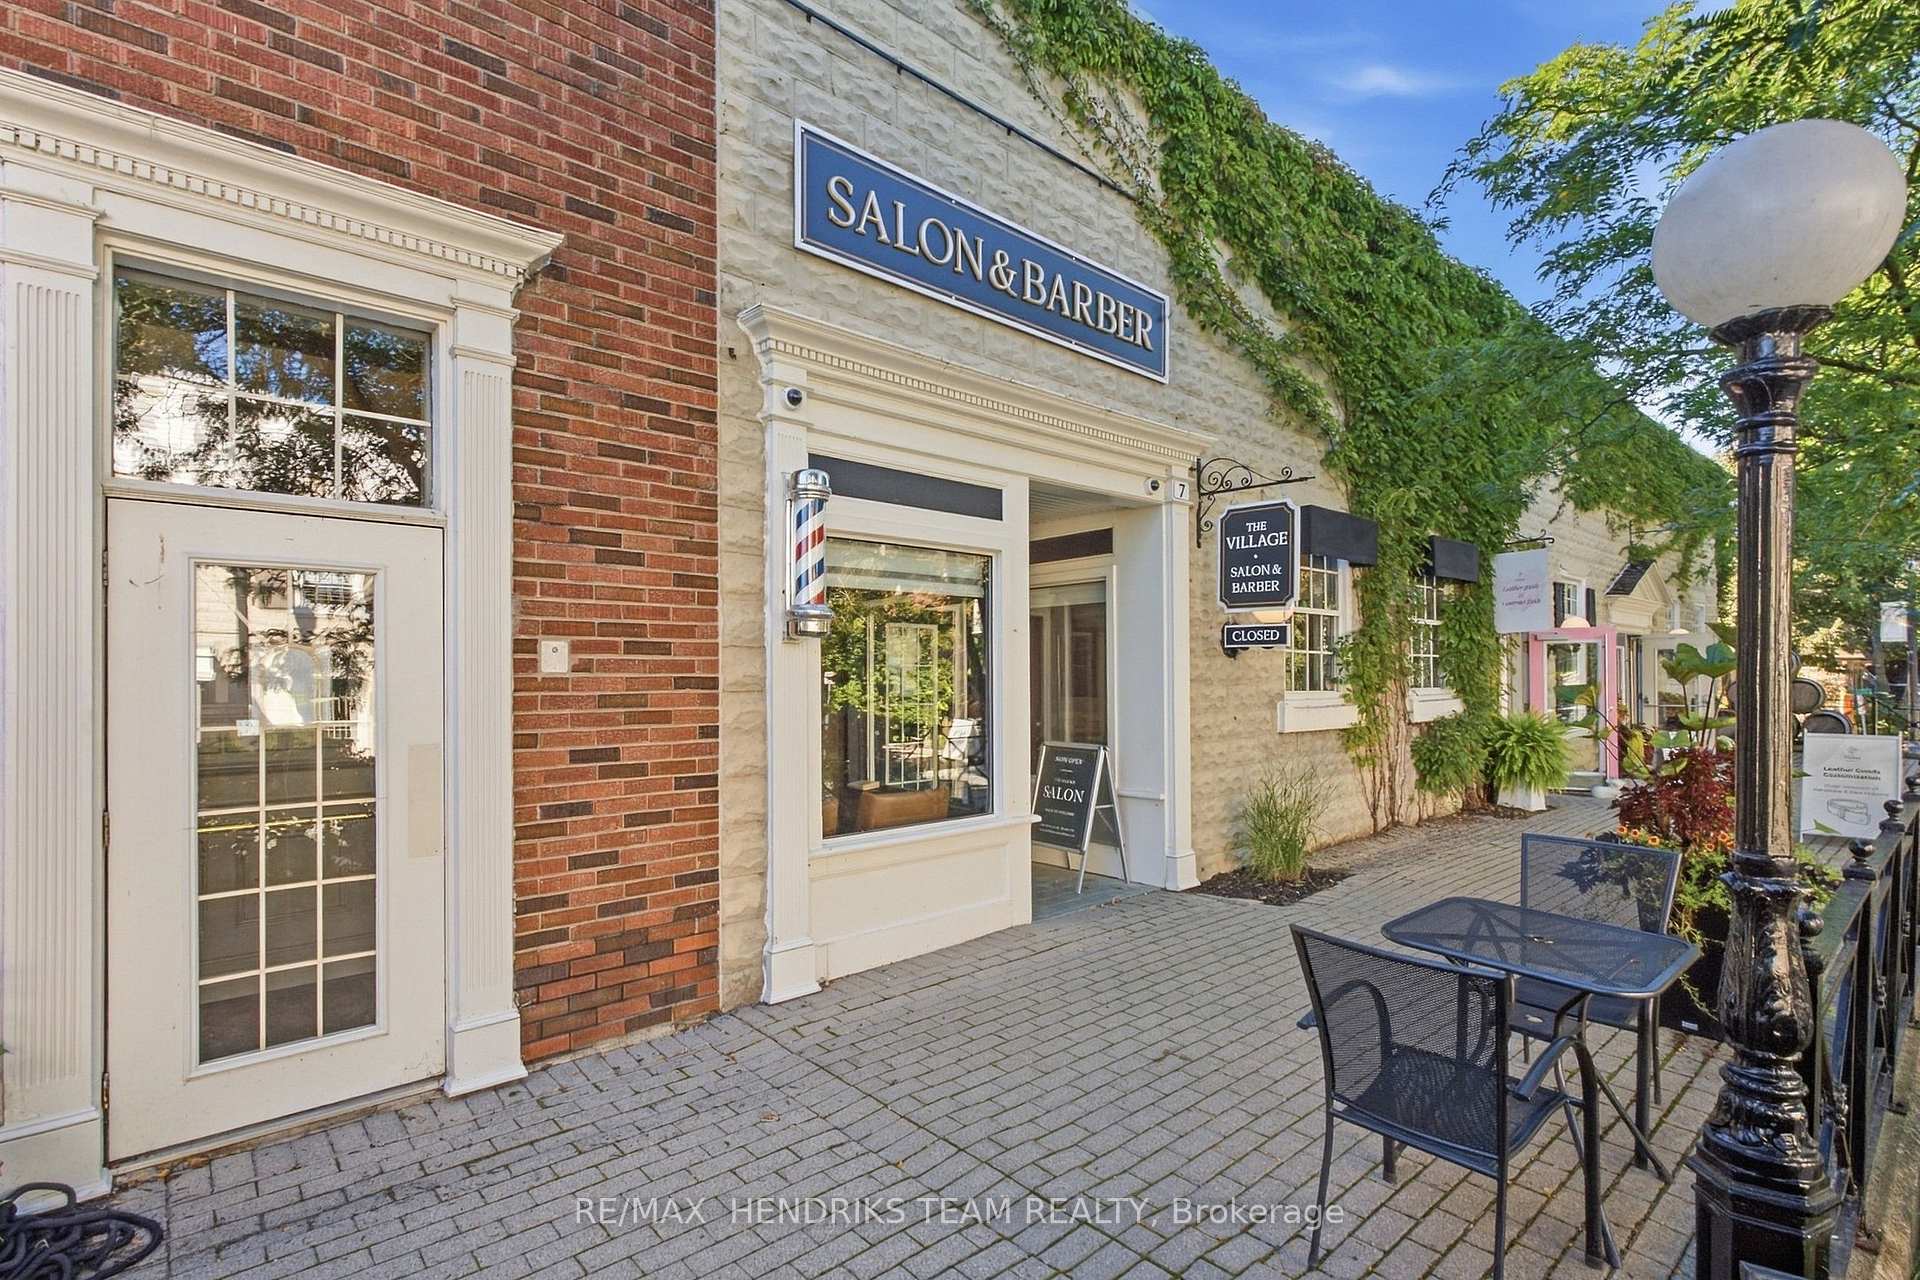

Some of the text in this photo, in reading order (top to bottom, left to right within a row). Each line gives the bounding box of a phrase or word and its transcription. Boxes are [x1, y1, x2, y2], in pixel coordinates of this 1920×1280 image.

[1178, 483, 1186, 498] 7
[1246, 521, 1267, 533] THE
[1226, 531, 1288, 550] VILLAGE
[1230, 563, 1282, 578] SALON &
[1232, 580, 1280, 594] BARBER
[1232, 629, 1280, 642] CLOSED
[1043, 785, 1085, 803] SALON
